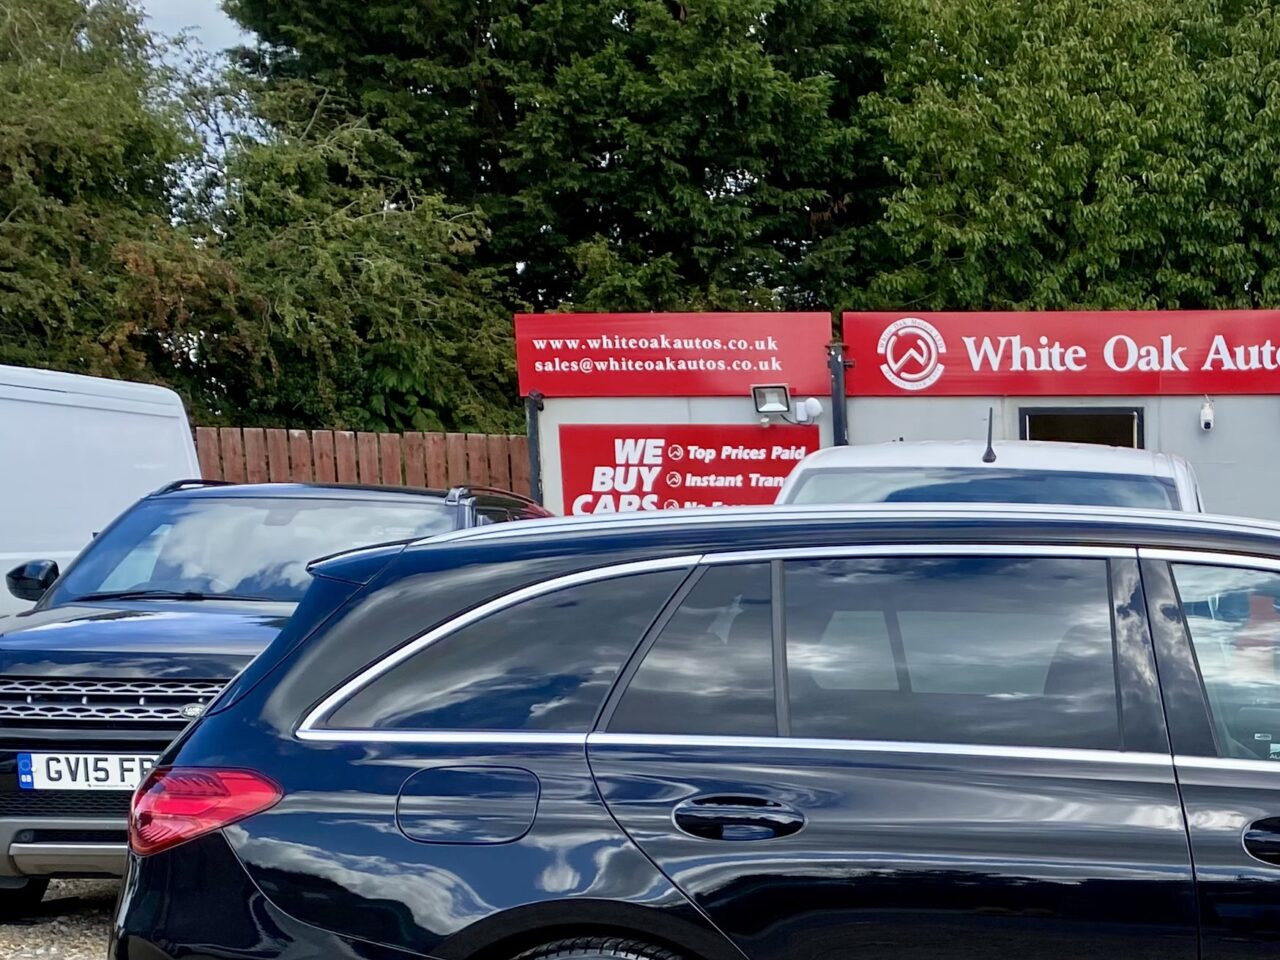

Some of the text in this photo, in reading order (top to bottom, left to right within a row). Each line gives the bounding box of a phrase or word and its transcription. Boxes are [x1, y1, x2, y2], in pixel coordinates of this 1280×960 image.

[533, 334, 779, 351] www.whiteoakautos.co.uk
[962, 334, 1087, 371] White
[1103, 334, 1189, 372] Oak
[534, 356, 782, 373] sales@whiteoakautos.co.uk
[614, 438, 665, 464] WE
[687, 445, 806, 463] Top Prices Paid
[592, 466, 662, 492] BUY
[685, 473, 785, 488] Instant Tran
[572, 494, 658, 516] CARS
[45, 756, 110, 783] GV15
